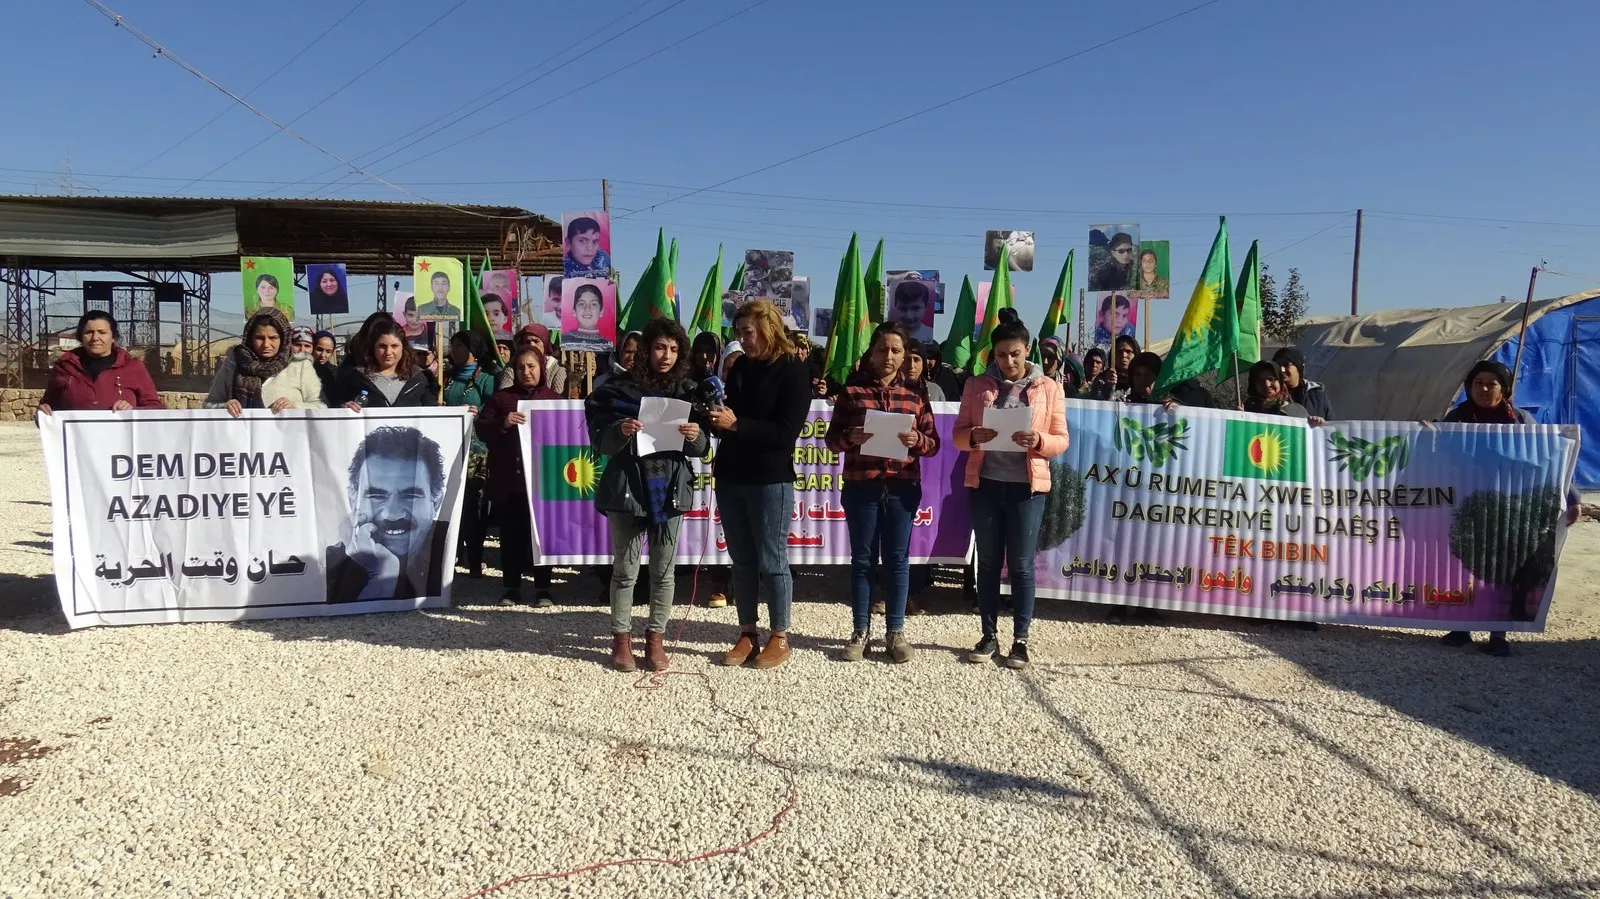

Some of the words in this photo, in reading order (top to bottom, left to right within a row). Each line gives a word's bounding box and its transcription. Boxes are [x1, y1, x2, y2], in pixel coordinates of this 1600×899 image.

[110, 453, 184, 479] DEM
[194, 451, 290, 478] DEMA
[794, 443, 840, 465] RÎNE
[793, 473, 833, 490] GAR
[1084, 463, 1120, 485] AX
[1124, 466, 1142, 488] Û
[1148, 472, 1248, 501] RUMETA
[1259, 484, 1313, 506] XWE
[1320, 484, 1456, 507] BIPARÊZIN
[107, 492, 249, 520] AZADIYE
[256, 486, 296, 517] YÊ
[913, 505, 934, 526] بر
[1111, 500, 1272, 531] DAGIRKERIYÊ
[1285, 514, 1301, 534] U
[1314, 514, 1379, 545] DAÊŞ
[1387, 516, 1401, 539] Ê
[1208, 534, 1254, 559] TÊK
[1261, 540, 1328, 563] BIBIN
[95, 551, 174, 588] الحرية
[181, 550, 238, 584] وقت
[247, 549, 307, 583] حان
[1061, 556, 1118, 582] وداعش
[1124, 561, 1192, 589] الإحتلال
[1199, 566, 1252, 594] وأنهوا
[1270, 573, 1355, 601] وكرامتكم
[1361, 580, 1416, 605] ترابكم
